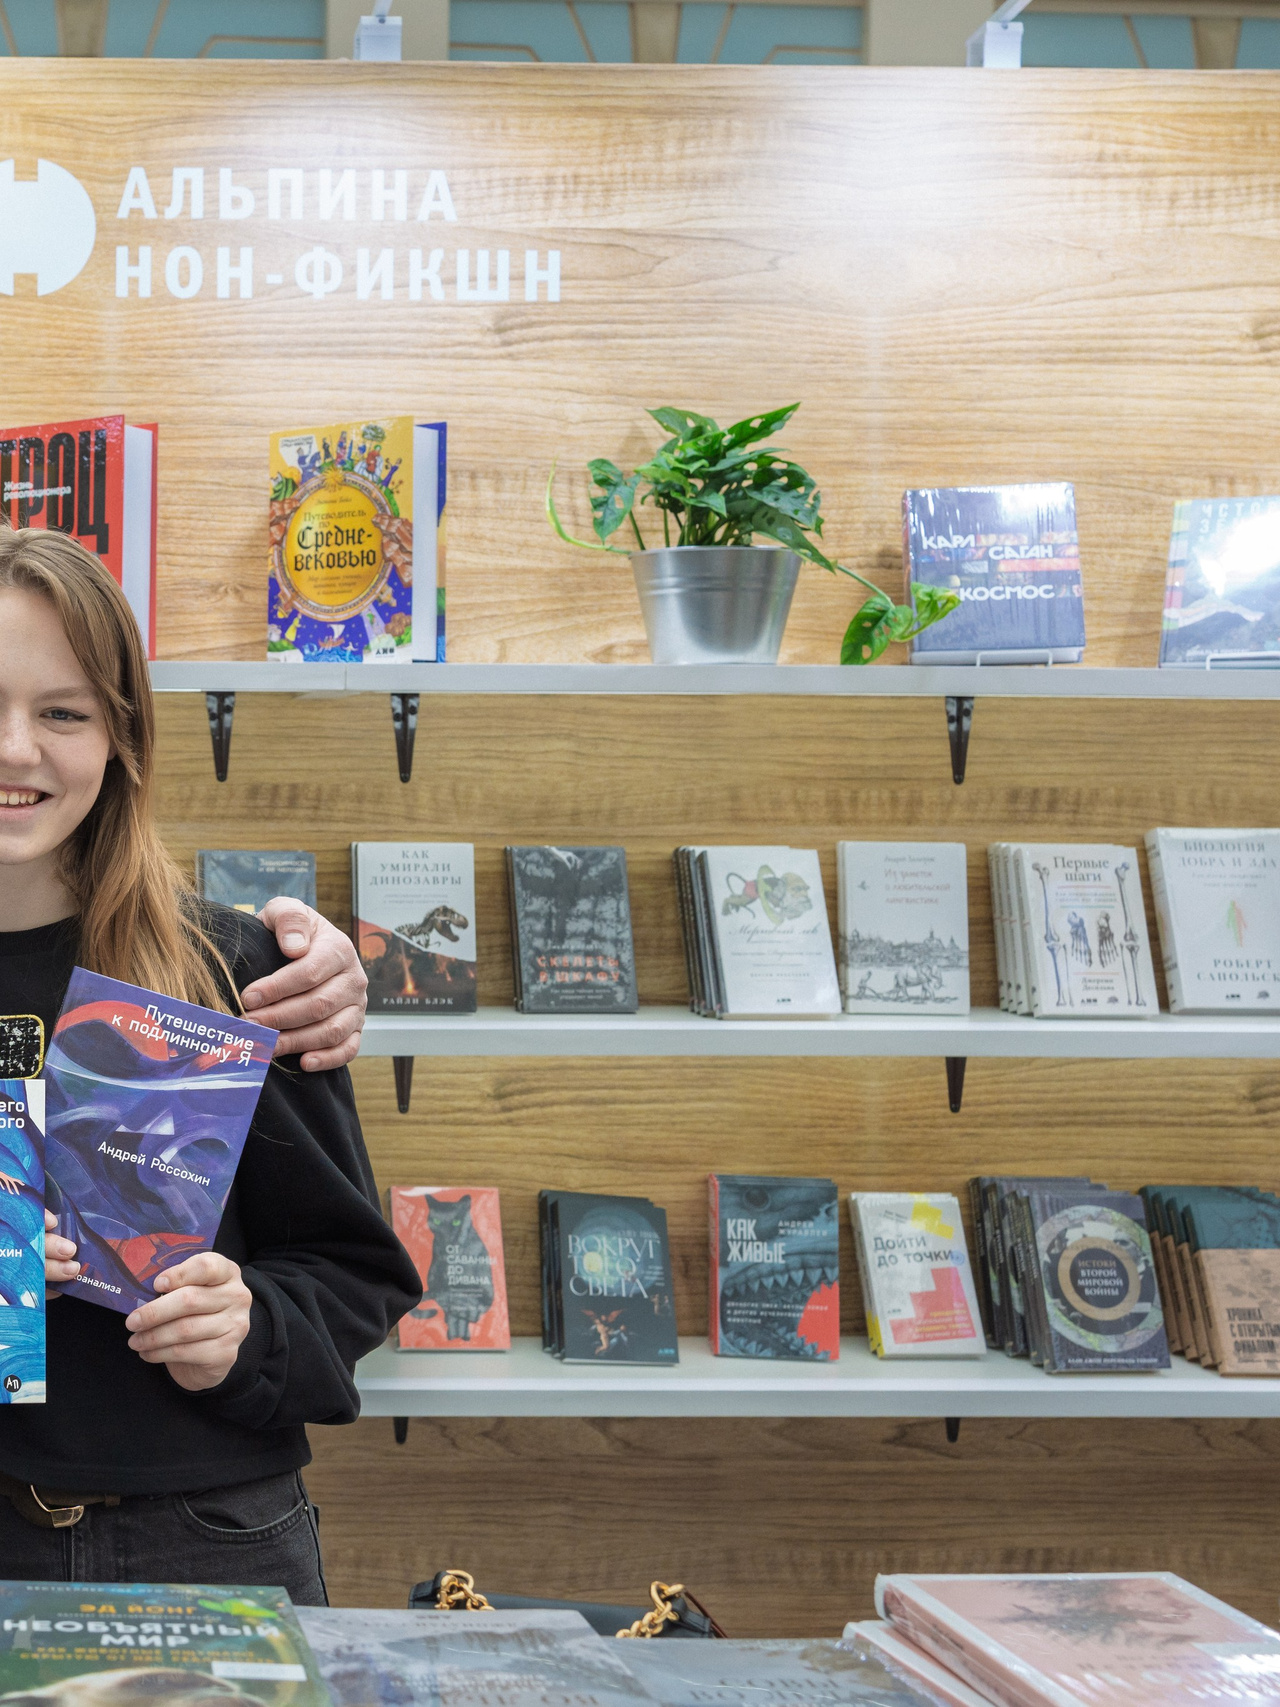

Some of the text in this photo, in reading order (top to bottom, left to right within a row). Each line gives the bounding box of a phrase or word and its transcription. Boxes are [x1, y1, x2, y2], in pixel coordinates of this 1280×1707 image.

[115, 166, 458, 222] АЛЬПИНА
[115, 245, 561, 303] НОН-ФИКШН
[921, 534, 975, 550] КАРЛ
[988, 545, 1054, 561] САГАН
[960, 584, 1055, 601] КОСМОС
[401, 850, 430, 860] КАК
[1183, 841, 1266, 853] БИОЛОГИЯ
[380, 862, 451, 873] УМИРАЛИ
[1053, 856, 1110, 873] Первые
[369, 875, 463, 887] ДИНОЗАВРЫ
[1064, 871, 1102, 882] шаги
[1197, 971, 1280, 982] САПОЛЬСК
[144, 1003, 255, 1051] Путешествие
[111, 1014, 252, 1067] к подлинному Я
[97, 1140, 211, 1187] Андрей Россохин
[726, 1218, 757, 1240] КАК
[568, 1235, 661, 1263] ВОКРУГ
[726, 1240, 786, 1264] ЖИВЫЕ
[568, 1254, 637, 1281] ТОГО
[570, 1278, 649, 1299] СВЕТА
[79, 1602, 197, 1615] ЭД ЙОНГ
[3, 1618, 281, 1638] НЕОБЪЯТНЫЙ
[100, 1633, 190, 1648] МИР
